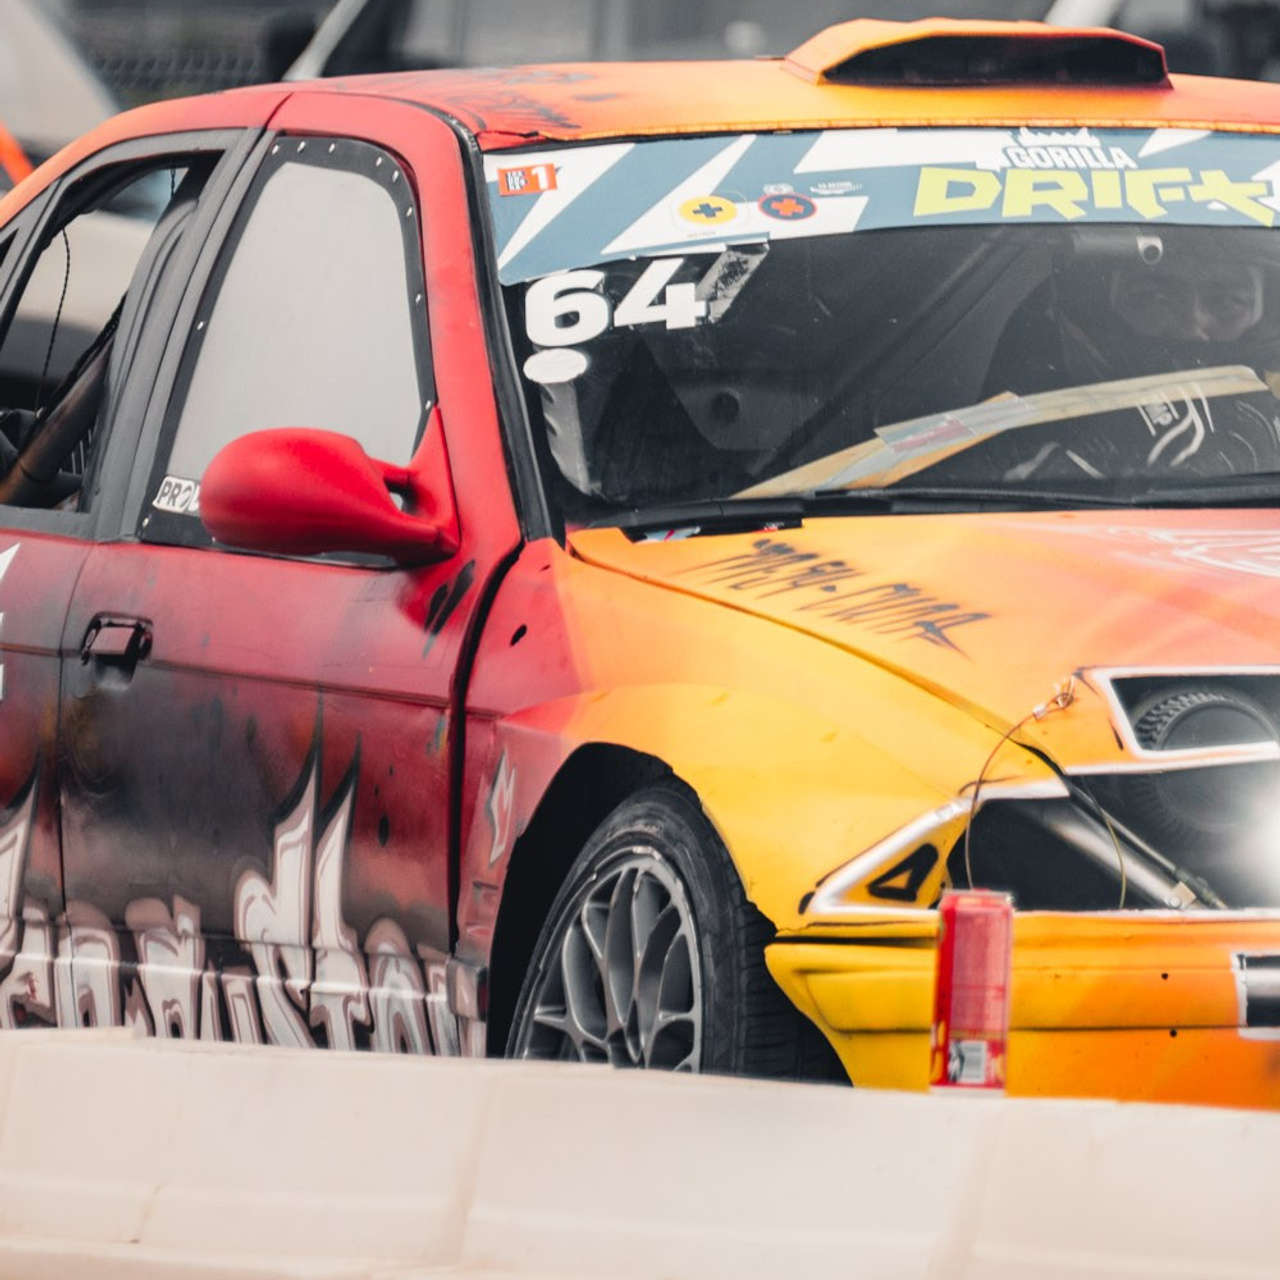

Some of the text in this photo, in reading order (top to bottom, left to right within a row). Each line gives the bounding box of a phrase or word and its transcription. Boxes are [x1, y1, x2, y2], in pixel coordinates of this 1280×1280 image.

[1004, 145, 1137, 170] GORILLA
[912, 165, 1275, 228] DRIFT
[524, 257, 707, 348] 64
